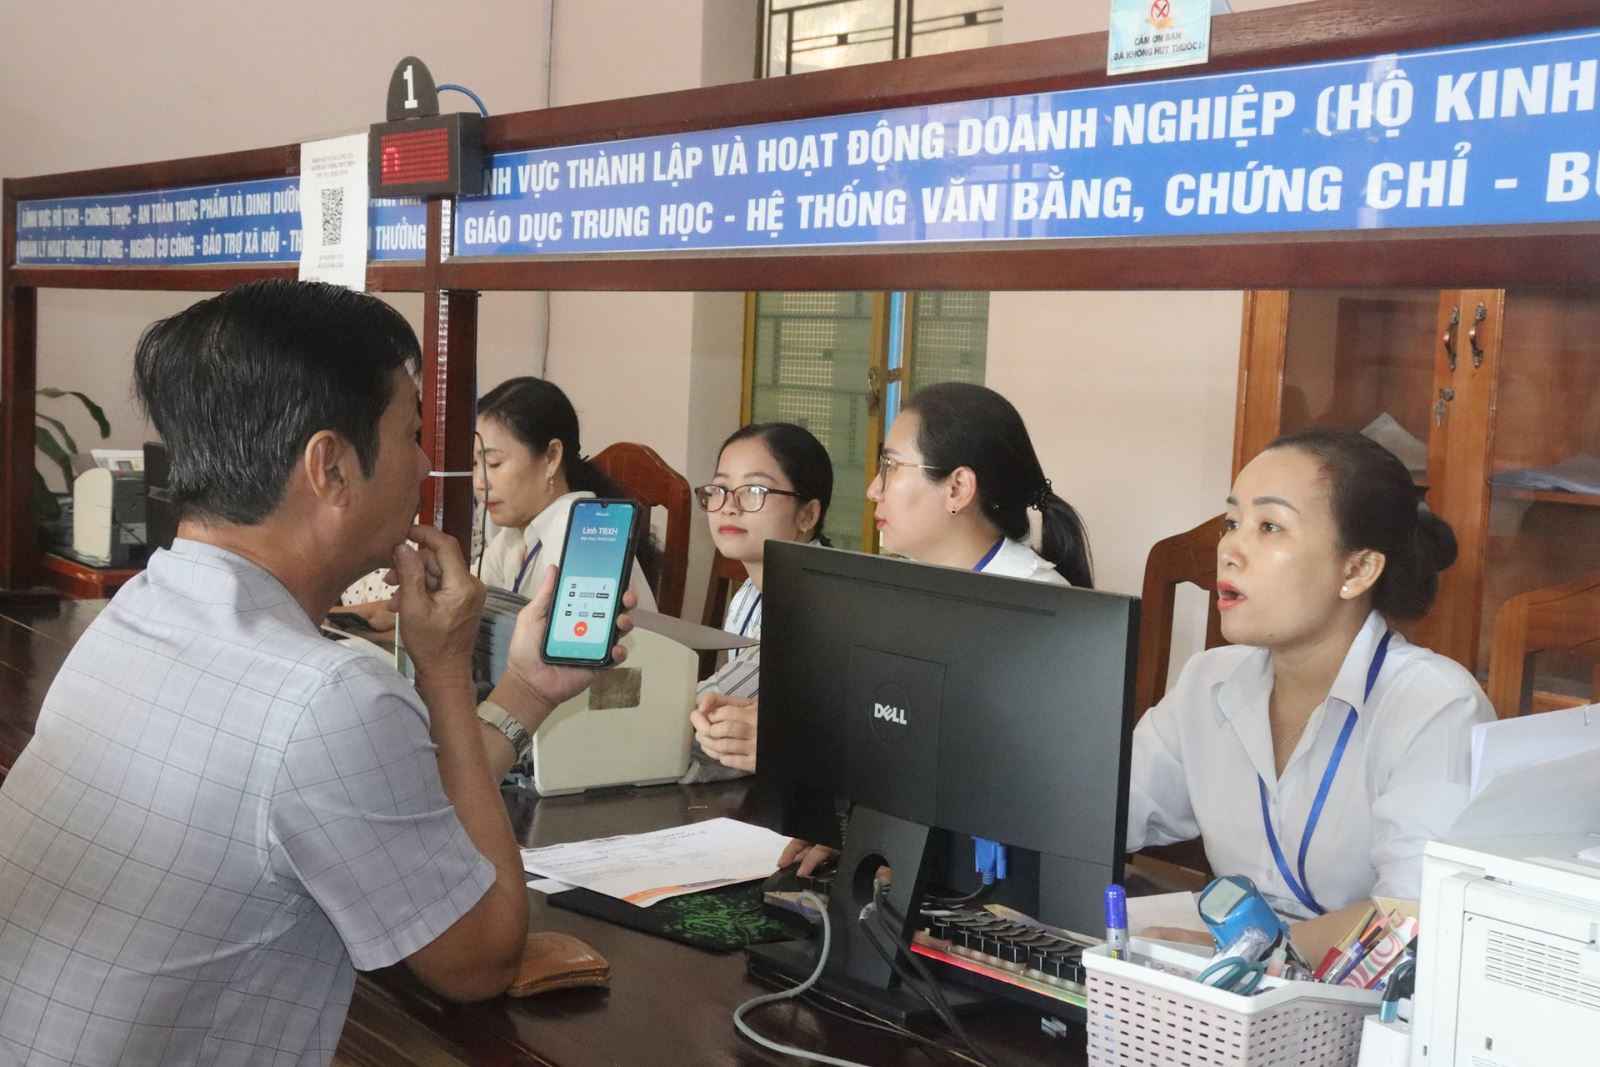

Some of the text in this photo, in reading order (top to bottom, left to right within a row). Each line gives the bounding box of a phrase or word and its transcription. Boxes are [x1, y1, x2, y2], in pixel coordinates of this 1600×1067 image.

[403, 64, 418, 109] 1
[518, 160, 560, 198] VỰC
[567, 150, 646, 189] THÀNH
[653, 142, 703, 187] LẬP
[712, 135, 748, 177] VÀ
[757, 132, 838, 177] HOẠT
[847, 119, 945, 171] ĐỘNG
[957, 107, 1098, 157] DOANH
[1112, 83, 1296, 148] NGHIỆP
[1316, 69, 1414, 138] (HỘ
[1435, 59, 1598, 123] KINH
[151, 198, 174, 224] TOÀN
[175, 198, 198, 225] THỰC
[200, 188, 228, 219] PHẨM
[230, 190, 243, 217] VÀ
[246, 192, 271, 216] DINH
[274, 185, 301, 213] DƯỠN
[464, 210, 512, 245] GIÁO
[518, 211, 563, 247] DỤC
[571, 206, 650, 240] TRUNG
[659, 201, 713, 241] HỌC
[746, 189, 785, 238] HỆ
[797, 179, 906, 229] THỐNG
[921, 177, 998, 224] VĂN
[1012, 165, 1144, 223] BẰNG,
[1165, 160, 1343, 217] CHỨNG
[1366, 141, 1472, 210] CHỈ
[170, 232, 195, 257] CÔNG
[202, 227, 221, 255] BẢO
[224, 230, 243, 258] TRỢ
[244, 227, 259, 253] XÃ
[261, 226, 280, 258] HỘI
[376, 216, 426, 250] THƯỞNG
[874, 702, 907, 725] DELL
